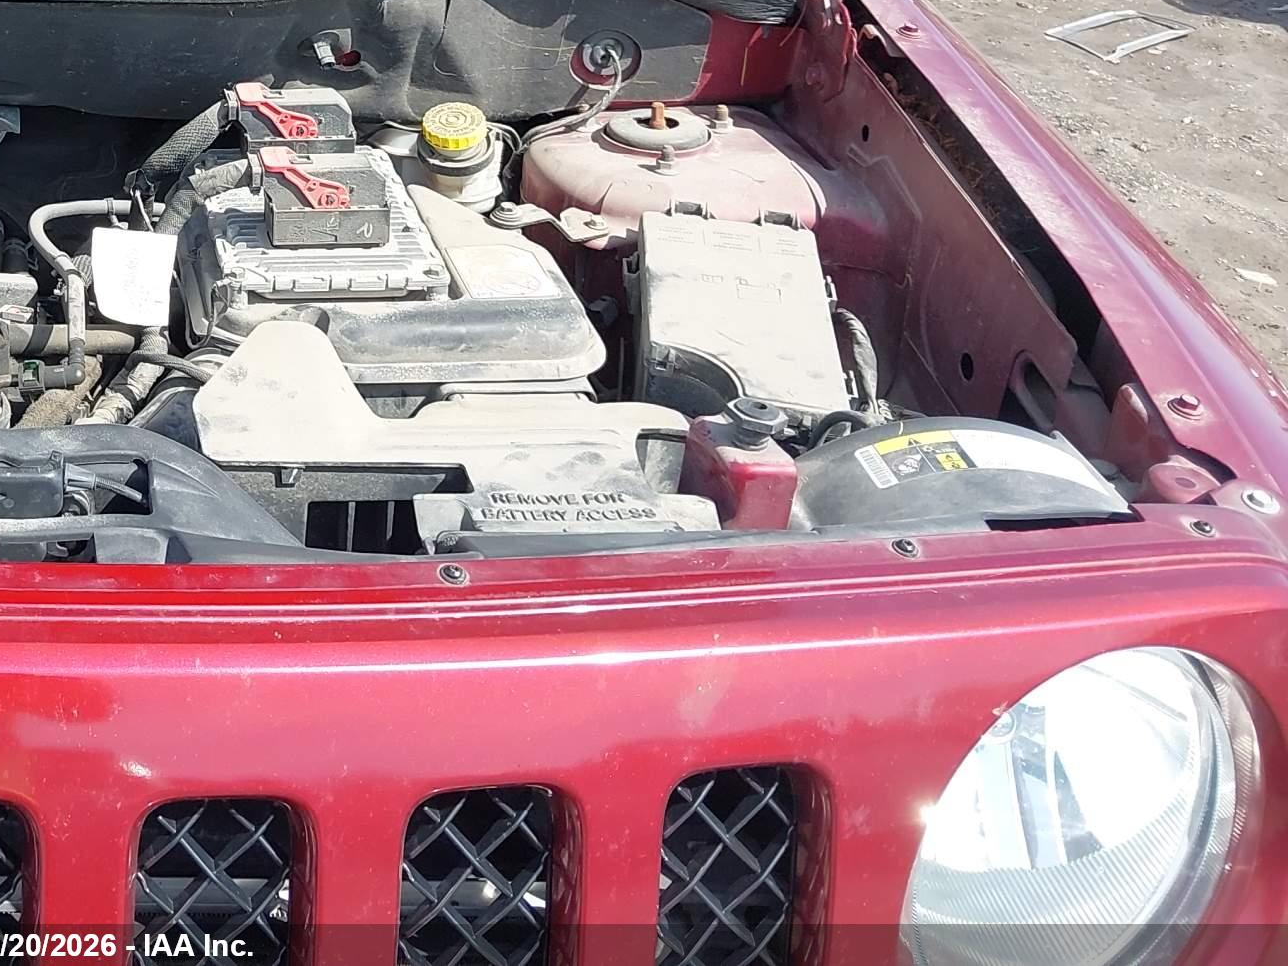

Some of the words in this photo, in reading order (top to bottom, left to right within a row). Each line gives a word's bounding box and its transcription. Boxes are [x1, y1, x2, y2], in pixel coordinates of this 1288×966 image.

[490, 491, 579, 506] REMOVE
[582, 491, 626, 506] FOR
[480, 507, 568, 522] BATTERY
[575, 507, 657, 522] ACCESS
